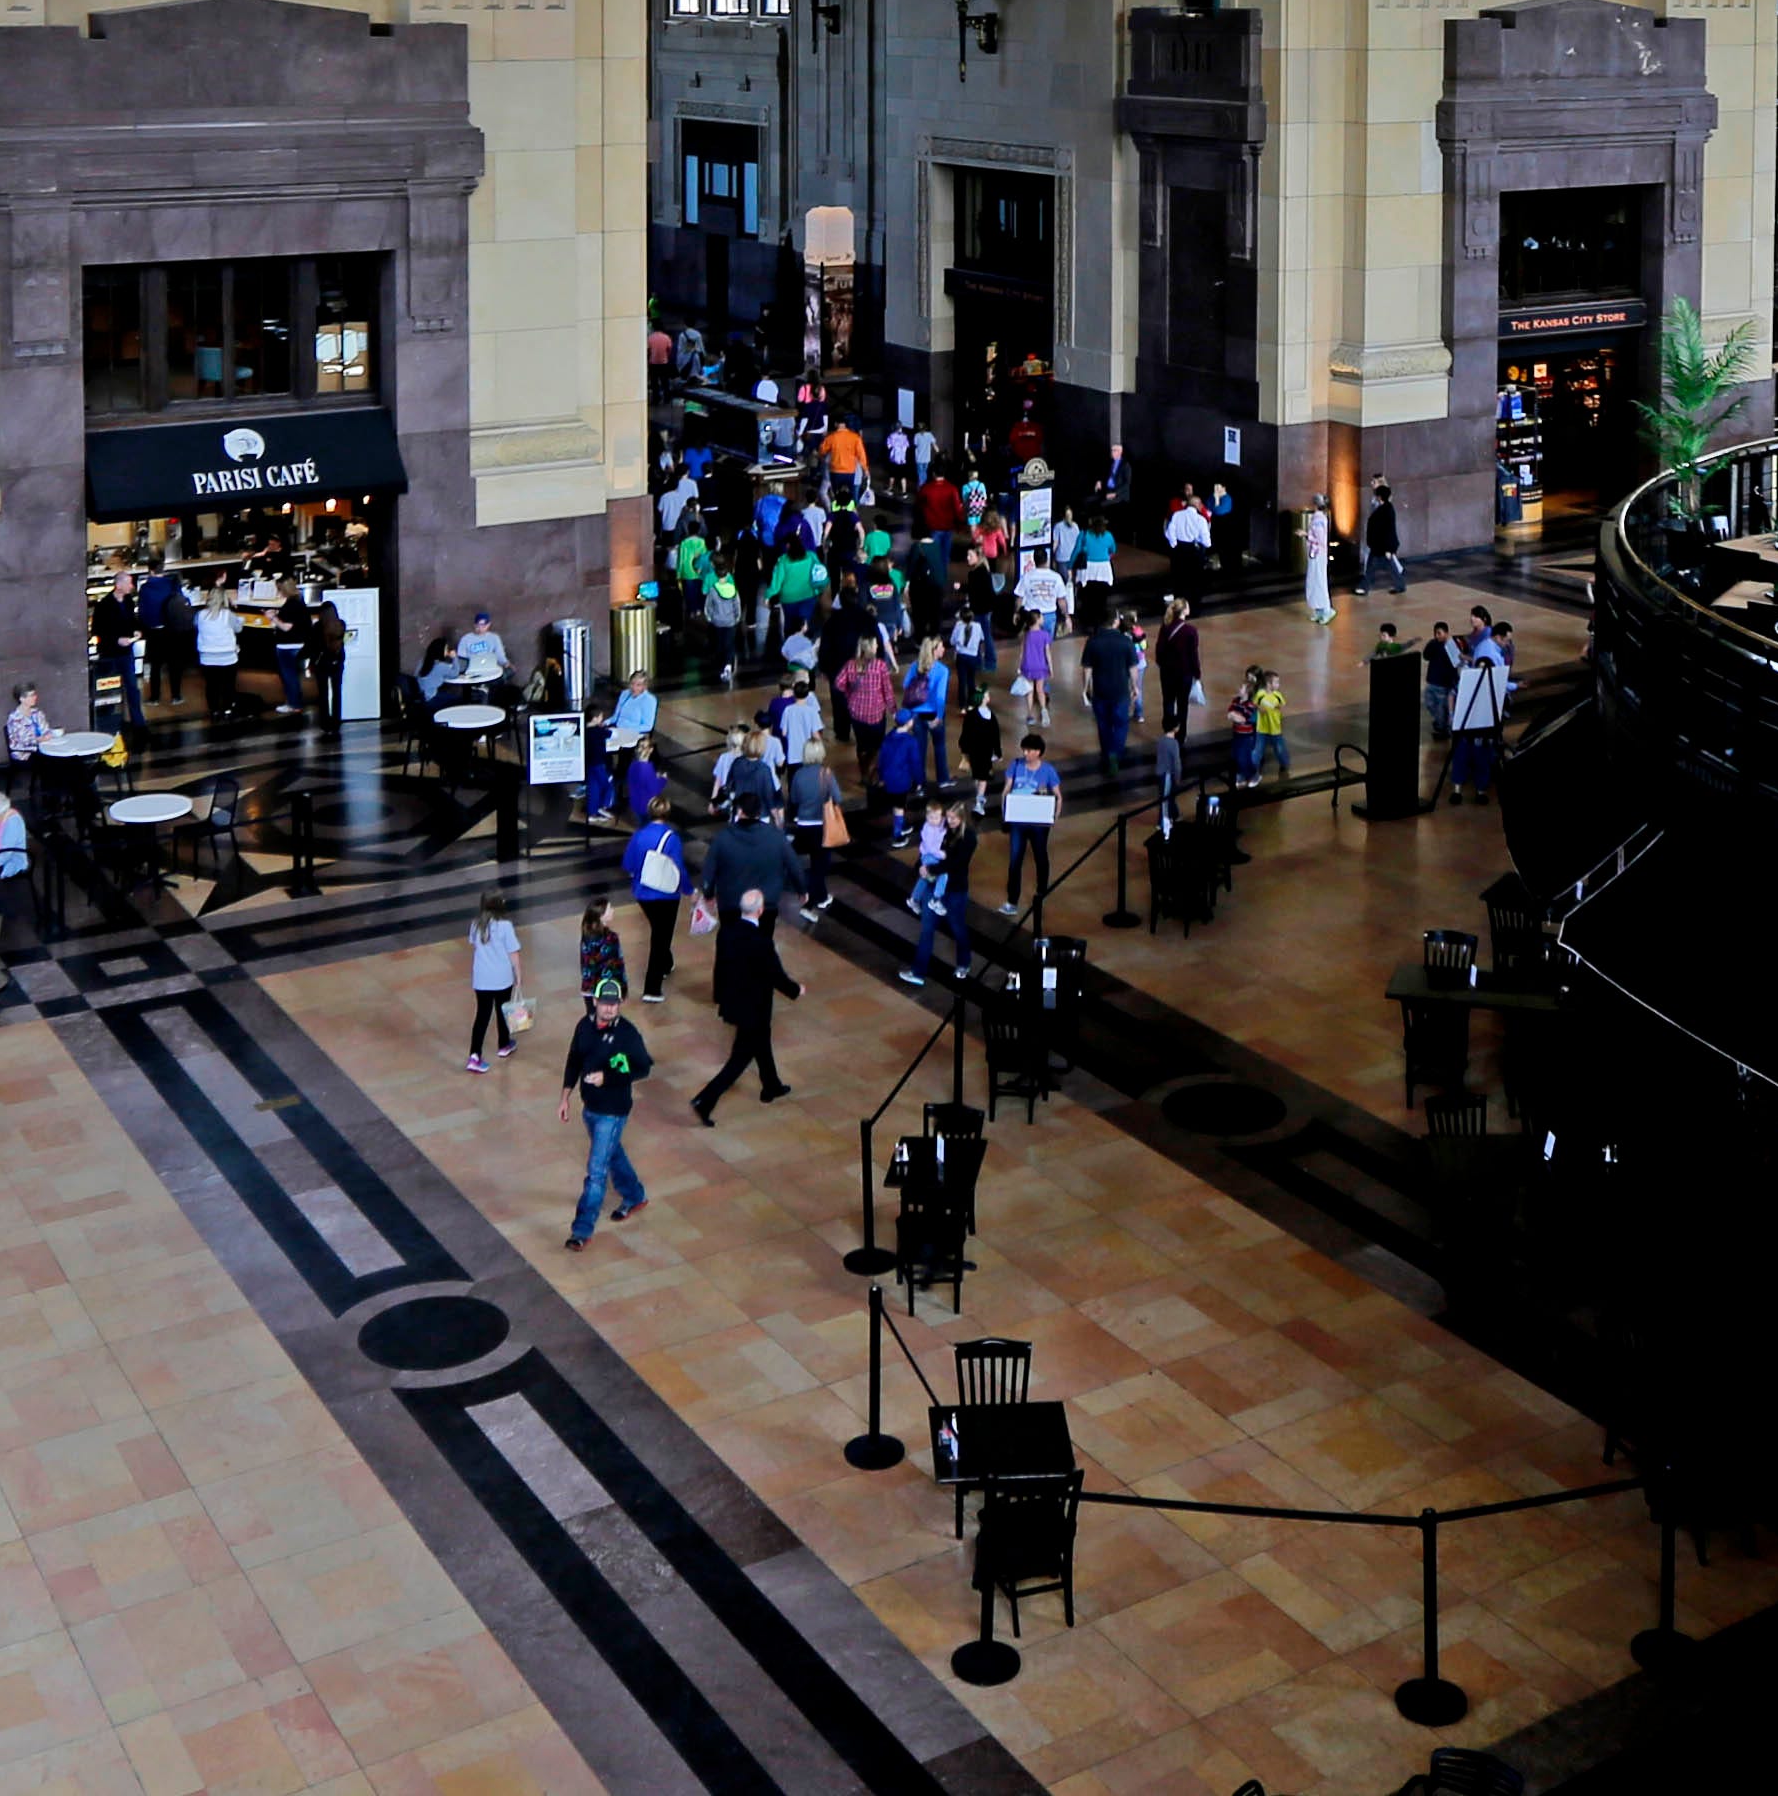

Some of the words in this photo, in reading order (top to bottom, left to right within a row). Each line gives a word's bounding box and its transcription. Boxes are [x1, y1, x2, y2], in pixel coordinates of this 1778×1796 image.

[1510, 320, 1531, 331] THE
[1532, 317, 1570, 330] KANSAS
[1571, 315, 1594, 326] CITY
[1596, 312, 1627, 323] STORE
[192, 467, 262, 495] PARISI
[266, 457, 319, 487] CAFÉ
